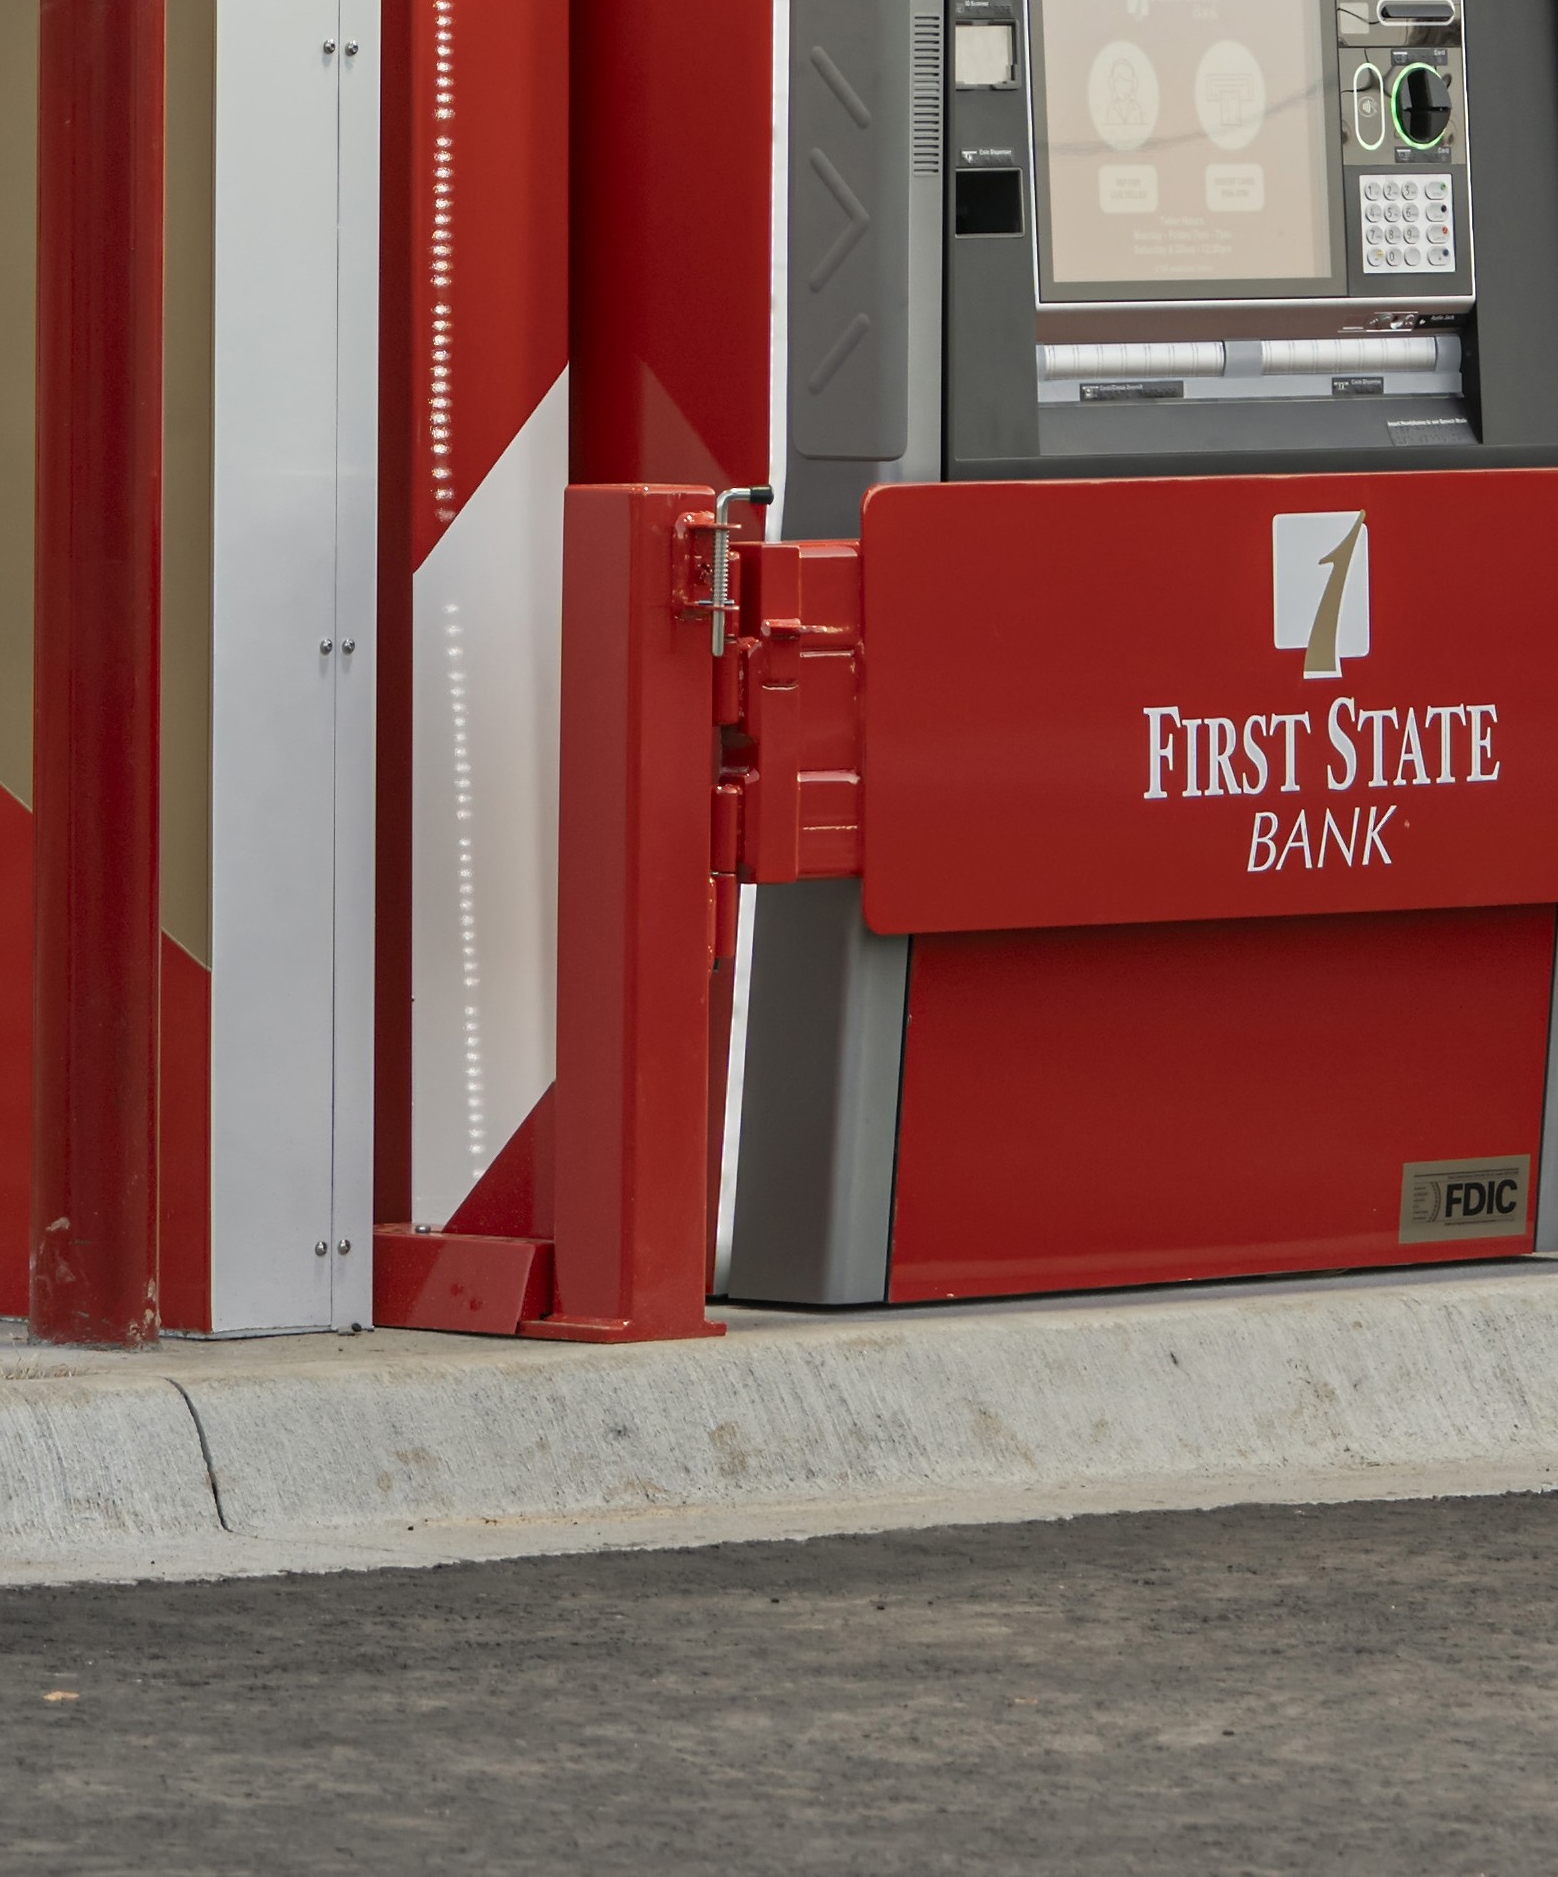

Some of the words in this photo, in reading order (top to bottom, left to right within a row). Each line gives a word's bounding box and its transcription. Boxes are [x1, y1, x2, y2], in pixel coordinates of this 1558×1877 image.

[1143, 705, 1310, 799] FIRST
[1326, 695, 1501, 792] STATE
[1246, 805, 1396, 872] BANK
[1445, 1179, 1517, 1218] FDIC
